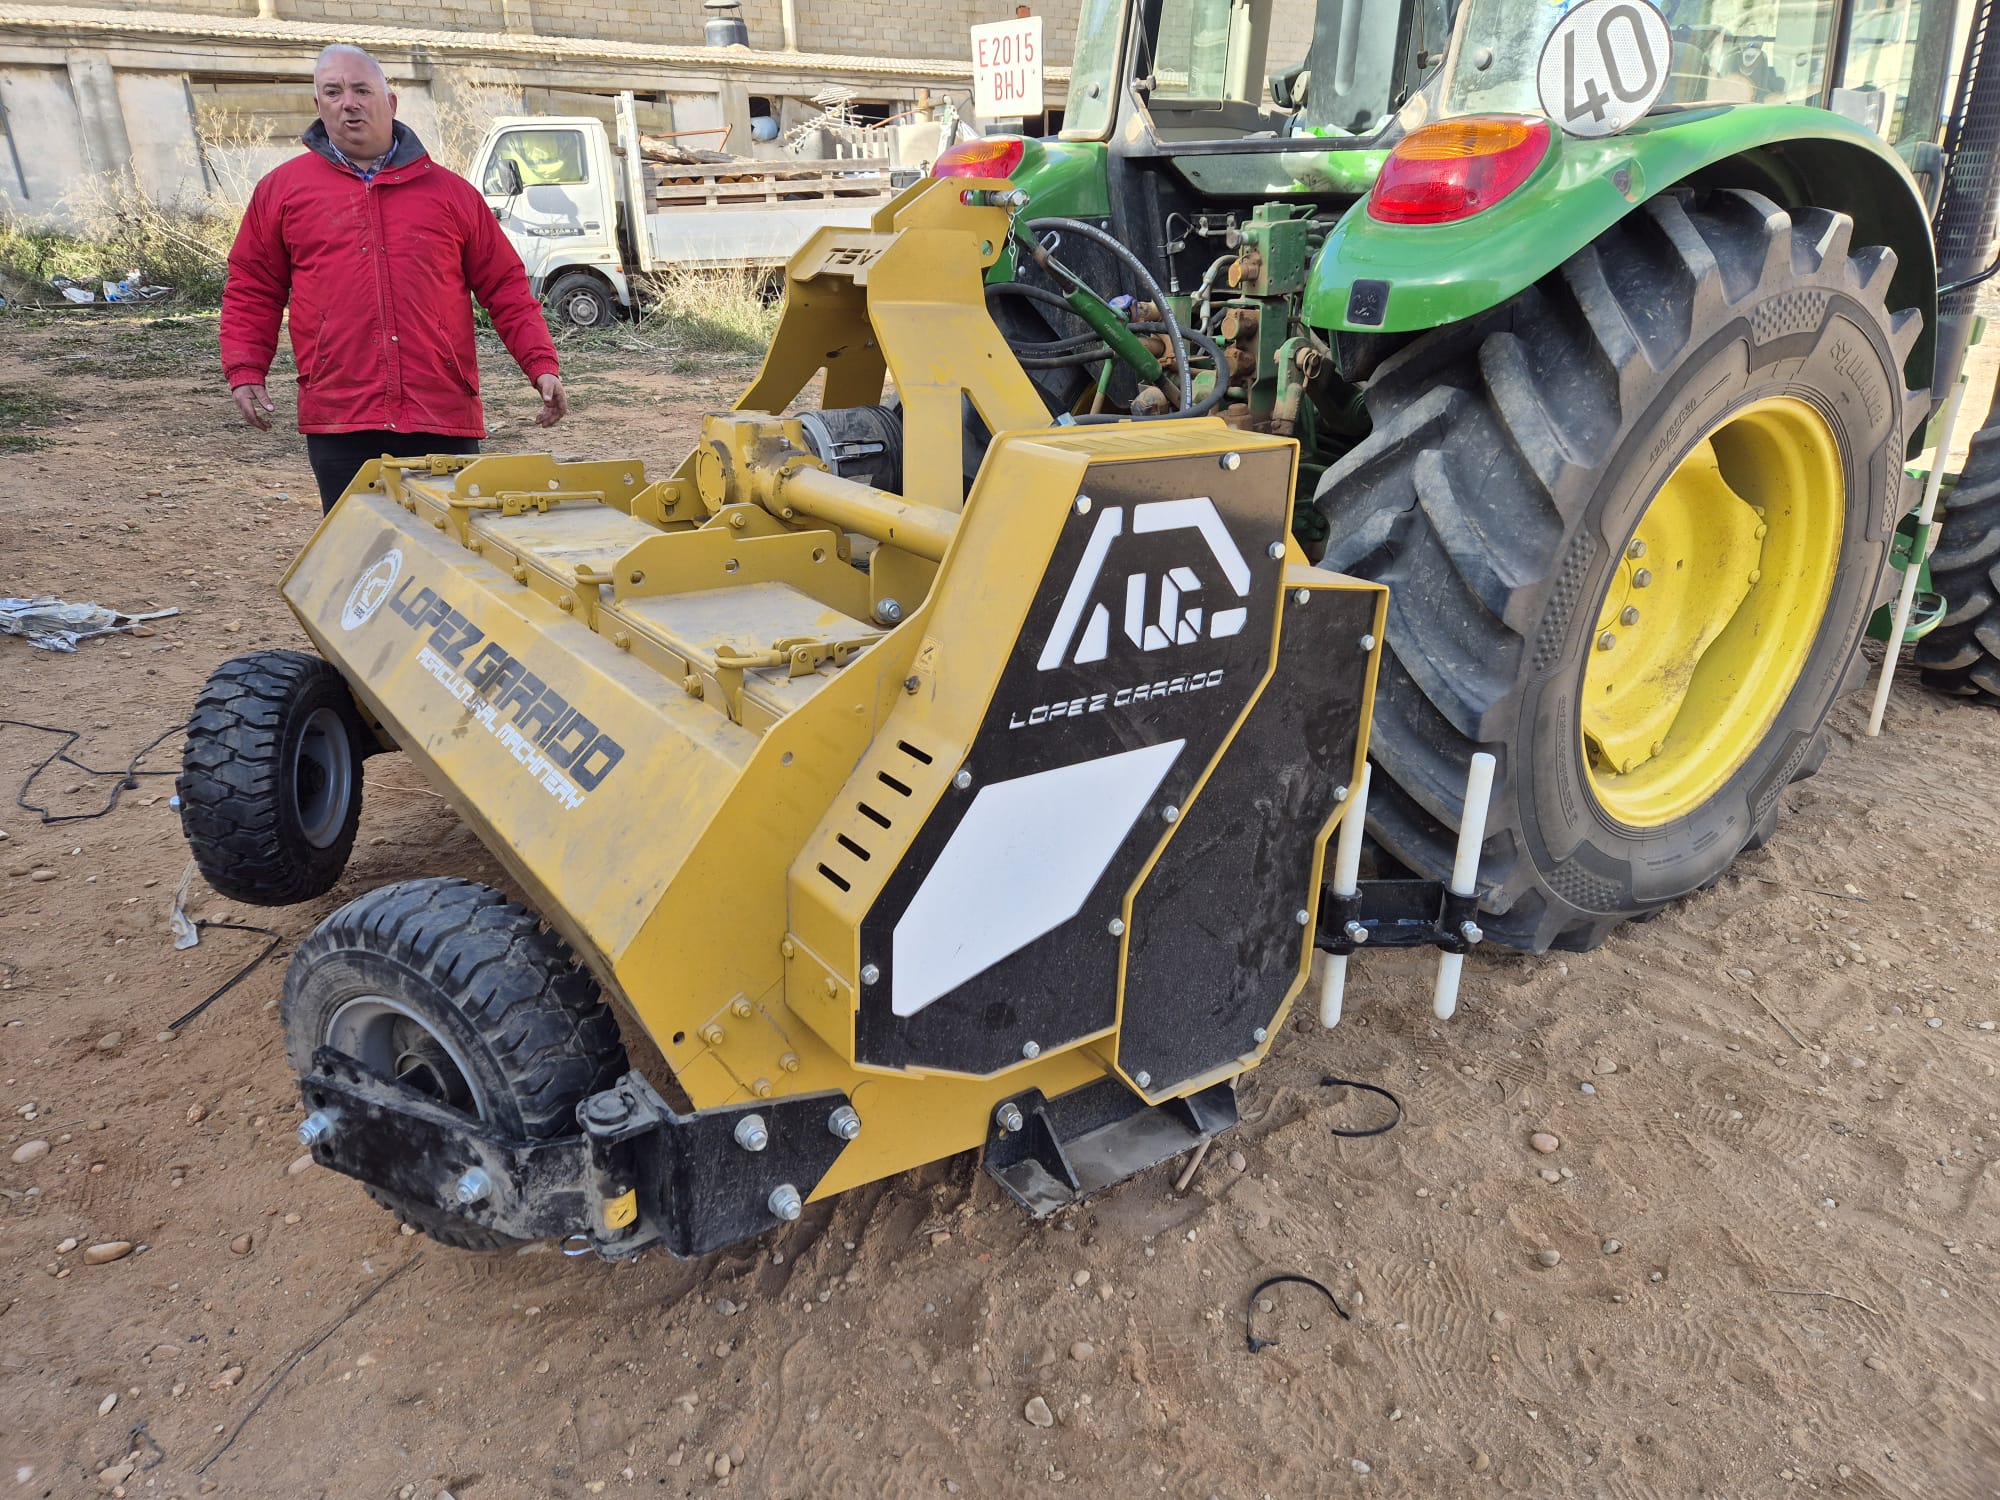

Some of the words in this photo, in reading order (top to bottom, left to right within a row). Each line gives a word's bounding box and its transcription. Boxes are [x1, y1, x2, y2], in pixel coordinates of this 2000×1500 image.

[994, 69, 1025, 101] BHJ
[1564, 4, 1657, 122] 40
[1833, 347, 1884, 429] ALLIANCE
[388, 575, 485, 668] LOPEZ
[464, 641, 625, 792] GARRIDO
[415, 646, 498, 732] AGRICULTURAL
[495, 722, 586, 810] MACHINERY
[1009, 693, 1108, 730] LOPEZ
[1113, 669, 1224, 707] GARRIDO
